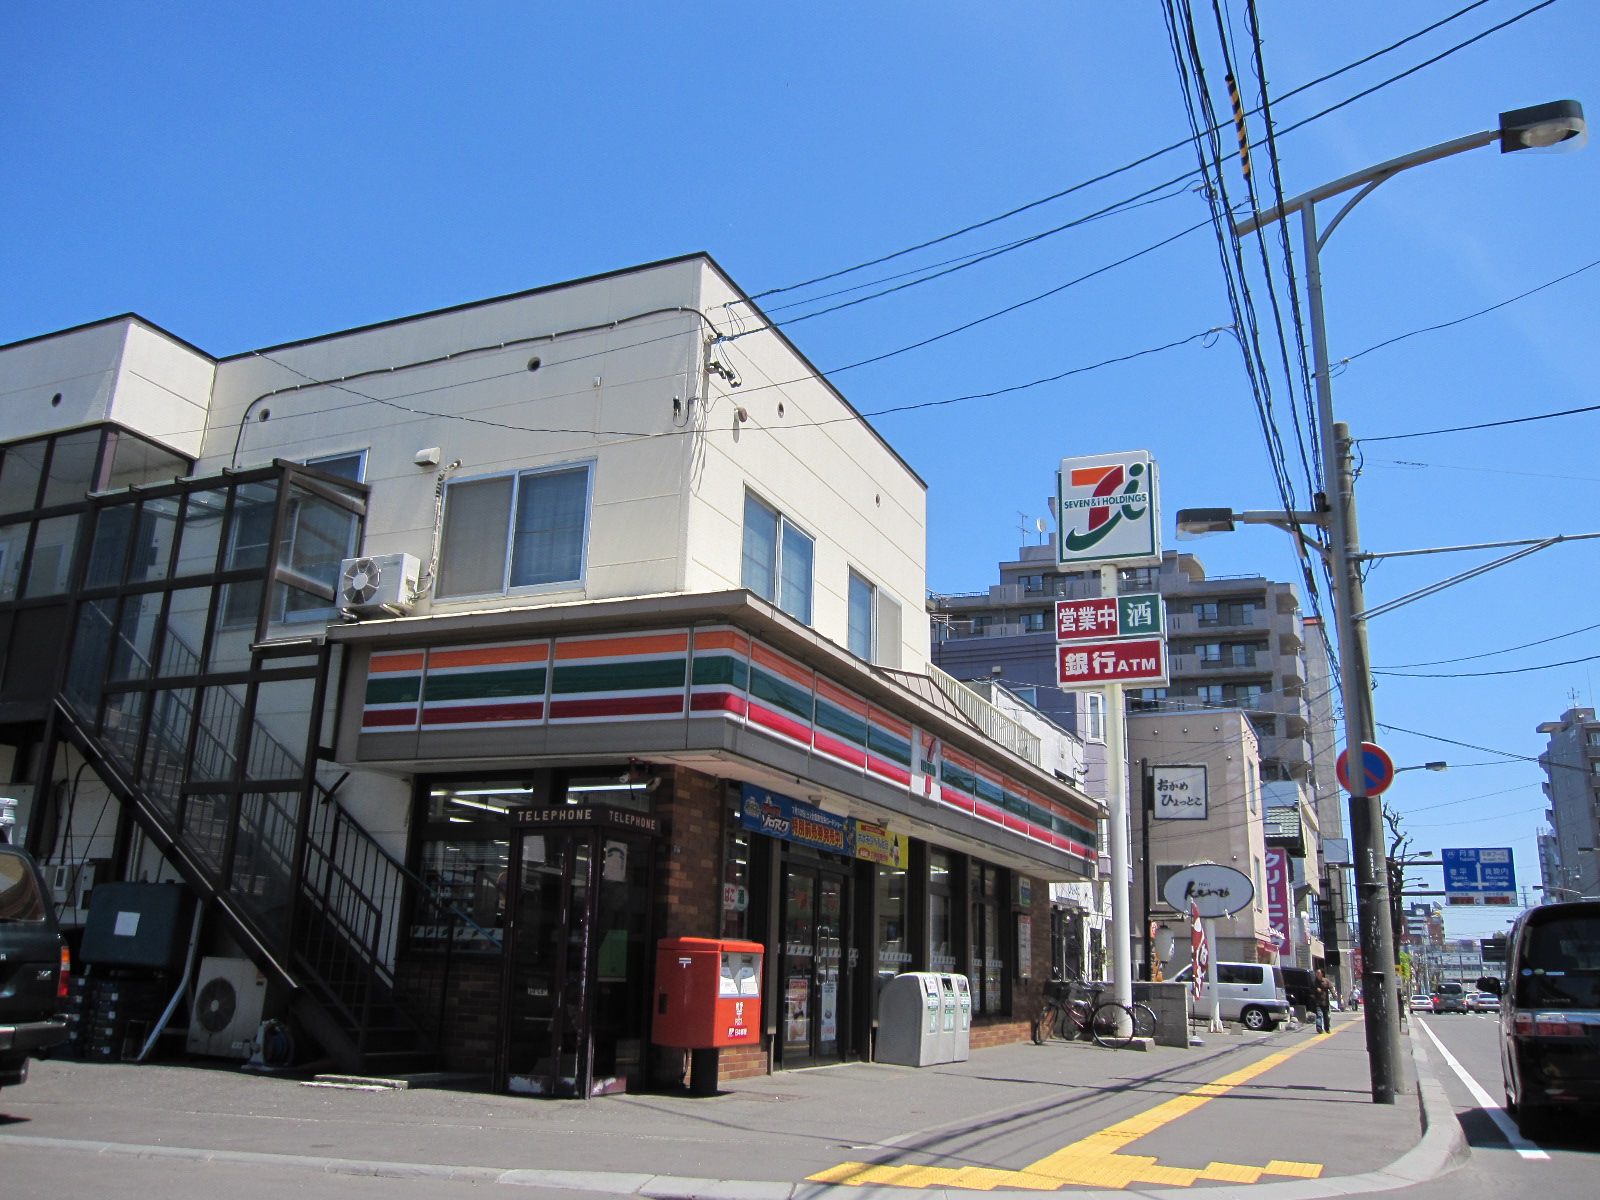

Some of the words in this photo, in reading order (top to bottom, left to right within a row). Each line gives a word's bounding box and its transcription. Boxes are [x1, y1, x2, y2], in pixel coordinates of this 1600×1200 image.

[1102, 493, 1147, 506] HOLDINGS
[1059, 605, 1116, 632] 営業中
[1127, 601, 1152, 627] 酒
[1157, 778, 1188, 792] おかめ
[1161, 794, 1202, 806] ひょっとこ
[517, 809, 592, 821] TELEPHONE
[609, 810, 656, 830] TELEPHONE
